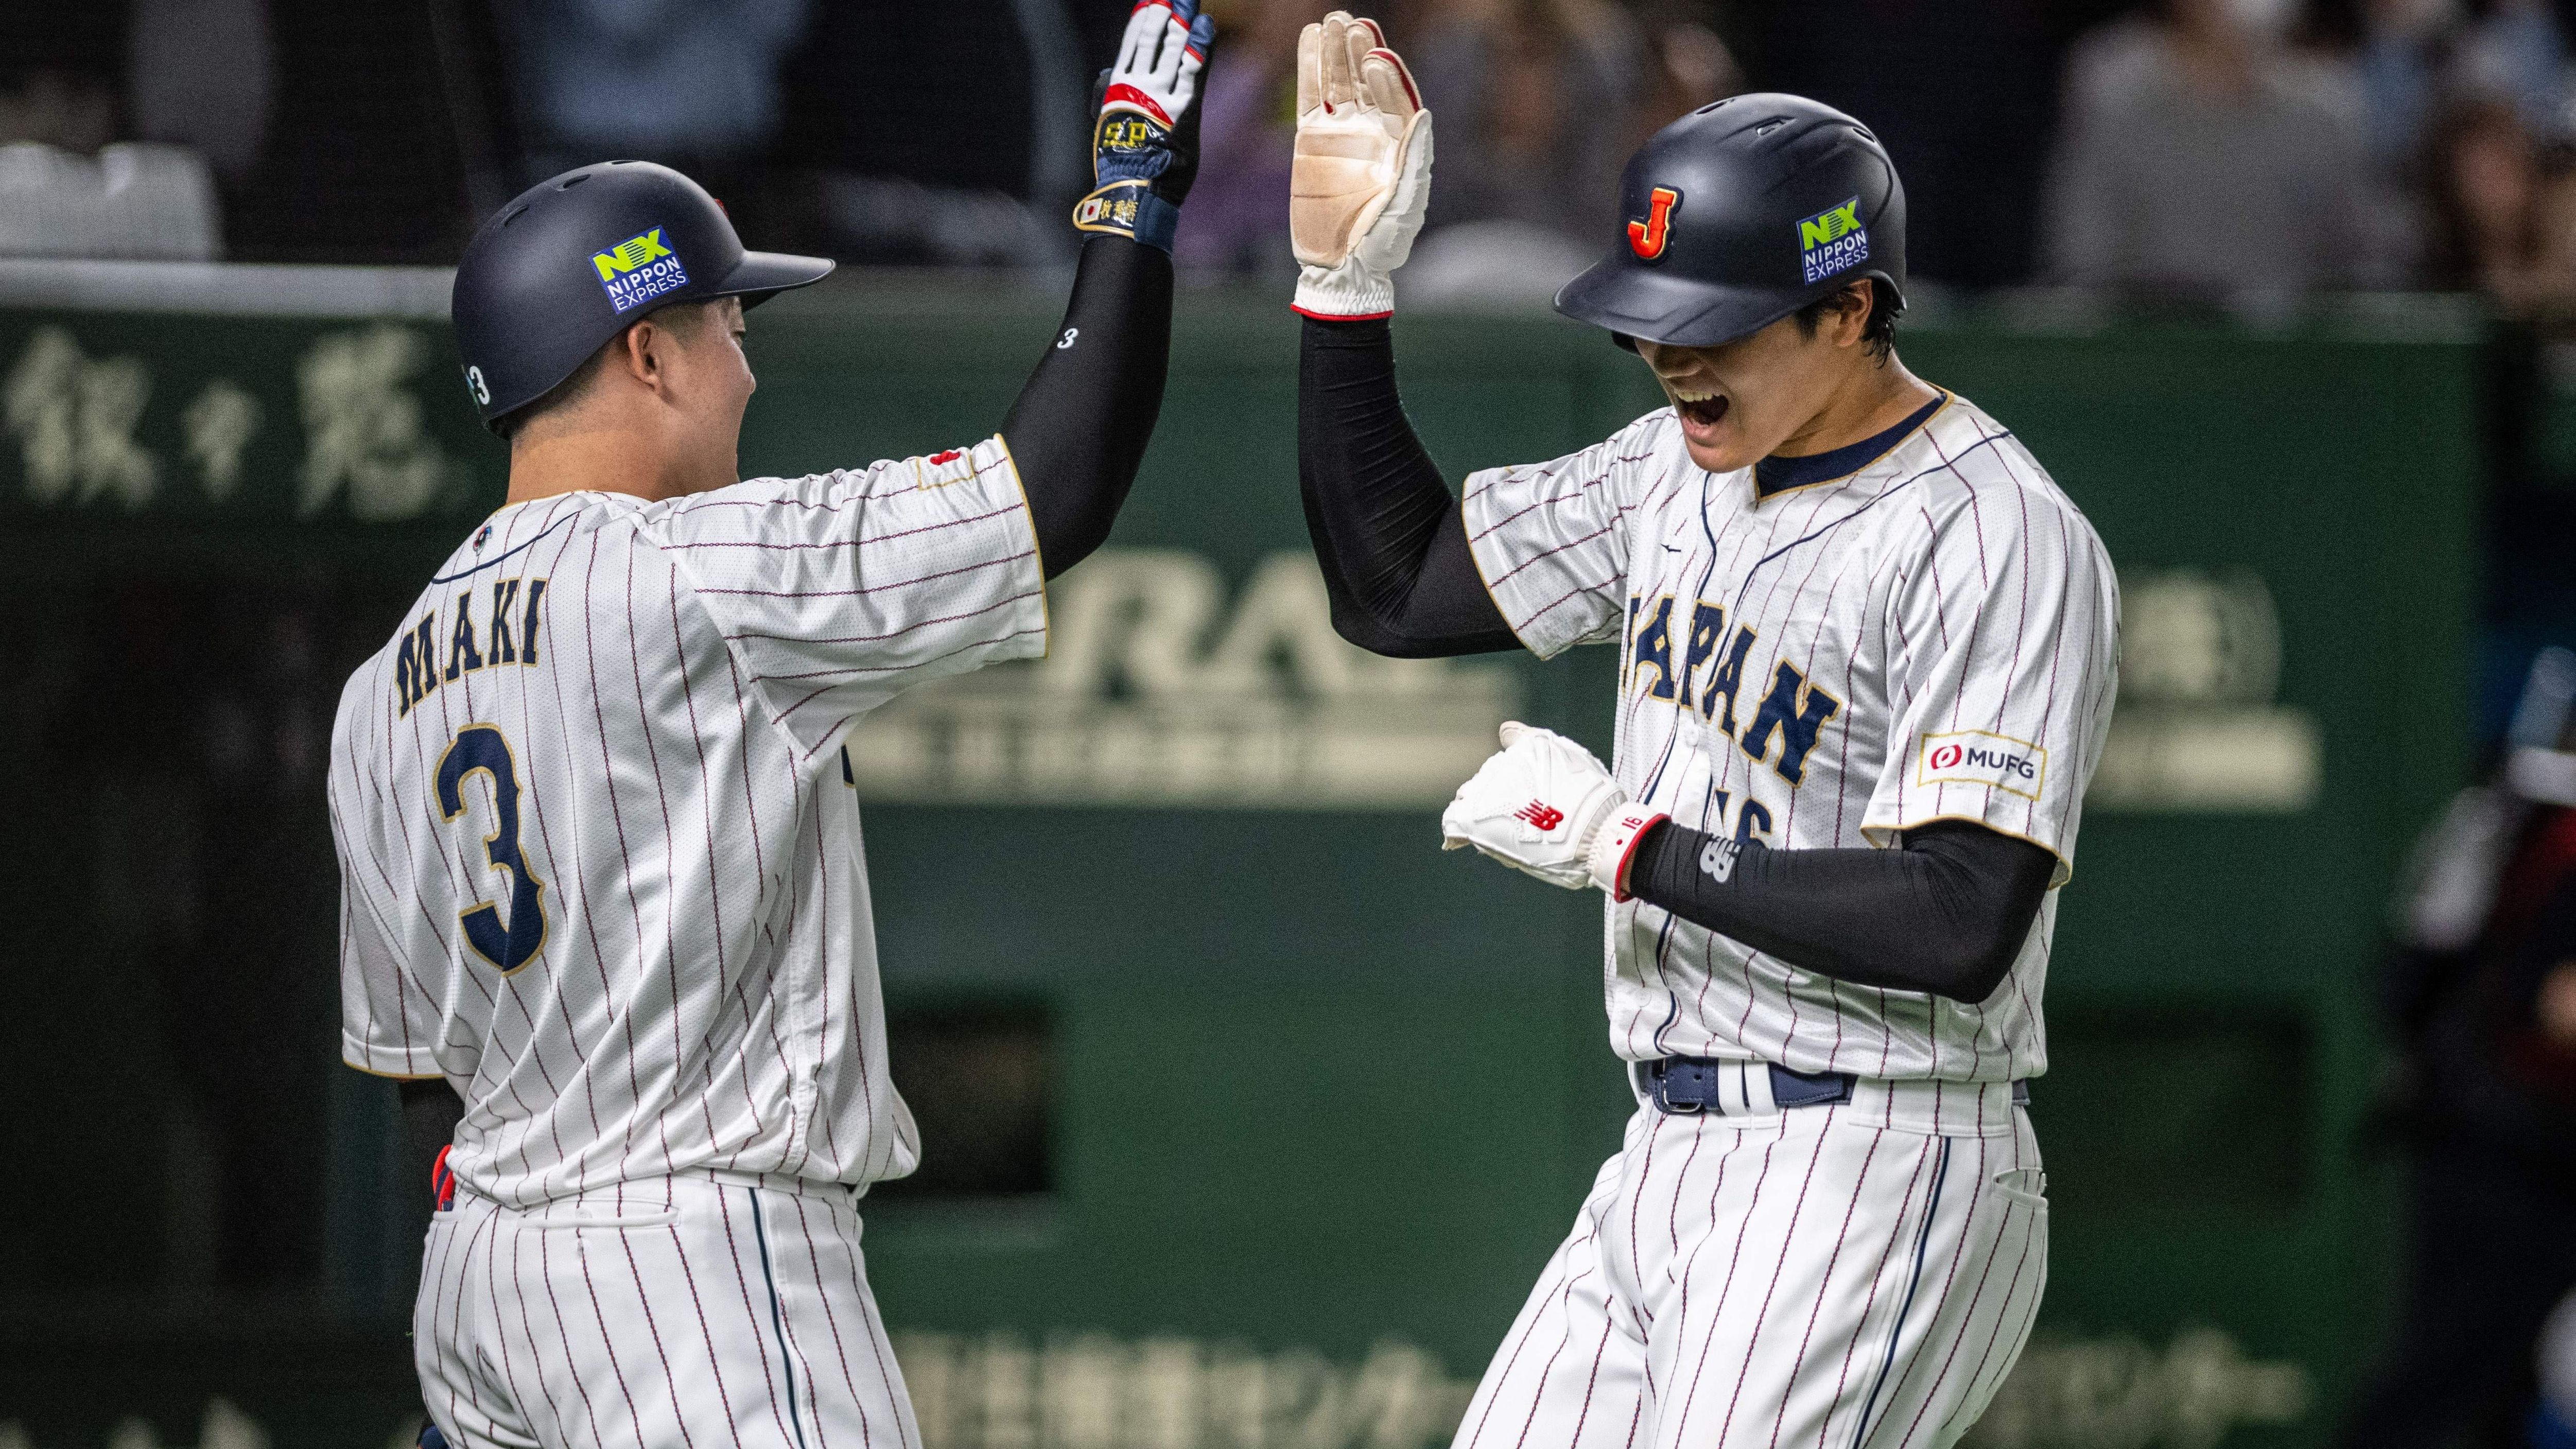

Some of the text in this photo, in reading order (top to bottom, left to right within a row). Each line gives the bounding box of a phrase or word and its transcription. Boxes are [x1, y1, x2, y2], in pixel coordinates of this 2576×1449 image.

[1628, 187, 1677, 259] J
[1800, 200, 1861, 251] NX
[593, 229, 672, 282] NX
[1805, 230, 1867, 267] NIPPON
[1807, 246, 1868, 282] EXPRESS
[607, 256, 681, 298] NIPPON
[614, 271, 686, 310] EXPRESS
[1057, 328, 1078, 349] 3
[469, 365, 490, 405] 3
[394, 577, 549, 720] MAKI
[1966, 747, 2034, 779] MUFG
[1622, 816, 1643, 830] 16
[432, 722, 548, 977] 3
